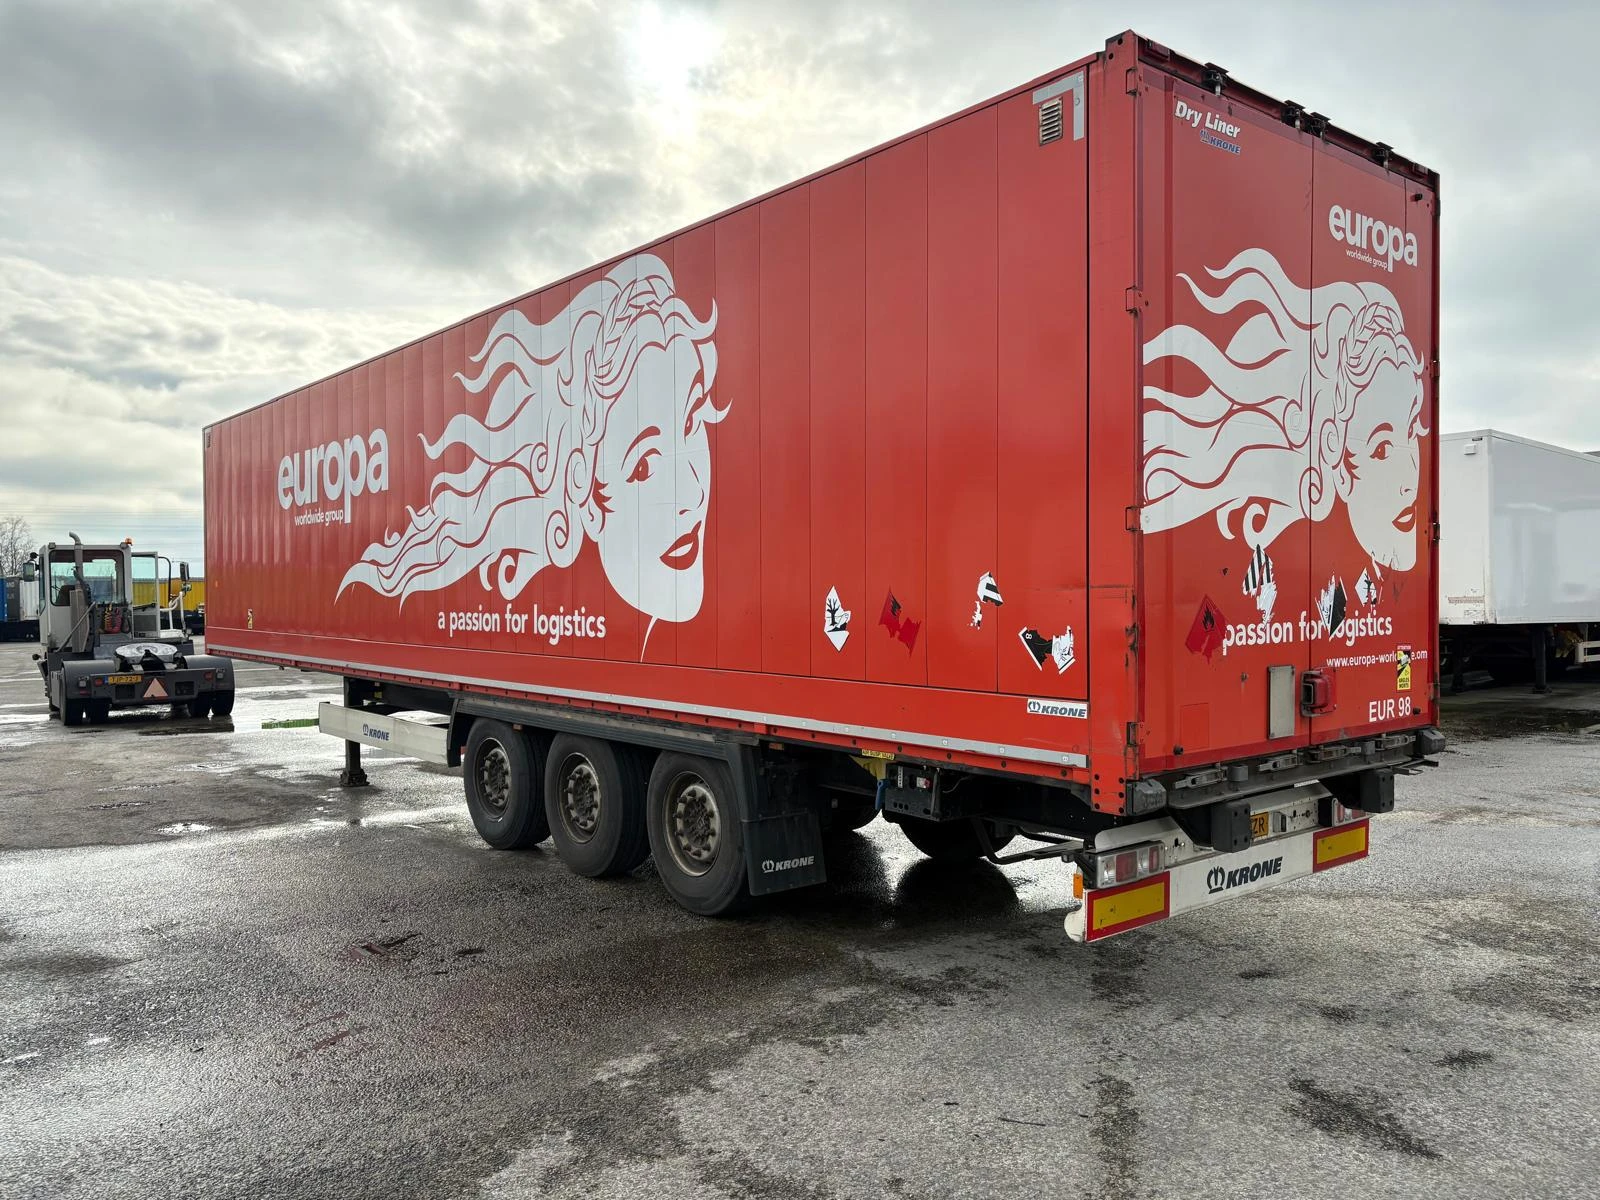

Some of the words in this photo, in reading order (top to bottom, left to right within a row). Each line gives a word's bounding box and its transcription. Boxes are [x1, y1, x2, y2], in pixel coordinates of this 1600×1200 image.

[1175, 100, 1203, 129] Dry
[1205, 111, 1241, 139] Liner
[1210, 137, 1241, 155] KRONE
[1328, 203, 1418, 273] europa
[1346, 248, 1373, 263] worldwide
[1373, 254, 1388, 269] group
[277, 428, 390, 524] europa
[294, 508, 325, 526] worldwide
[325, 509, 344, 527] group
[438, 611, 446, 630] a
[449, 604, 501, 637] passion
[505, 603, 528, 634] for
[533, 603, 606, 646] logistics
[1222, 617, 1293, 656] passion
[1299, 610, 1325, 642] for
[1335, 609, 1393, 647] ogistics
[1041, 705, 1086, 717] KRONE
[1369, 700, 1394, 722] EUR
[1398, 696, 1411, 716] 98
[369, 729, 390, 741] KRONE
[775, 856, 815, 872] KRONE
[1226, 857, 1283, 889] KRONE
